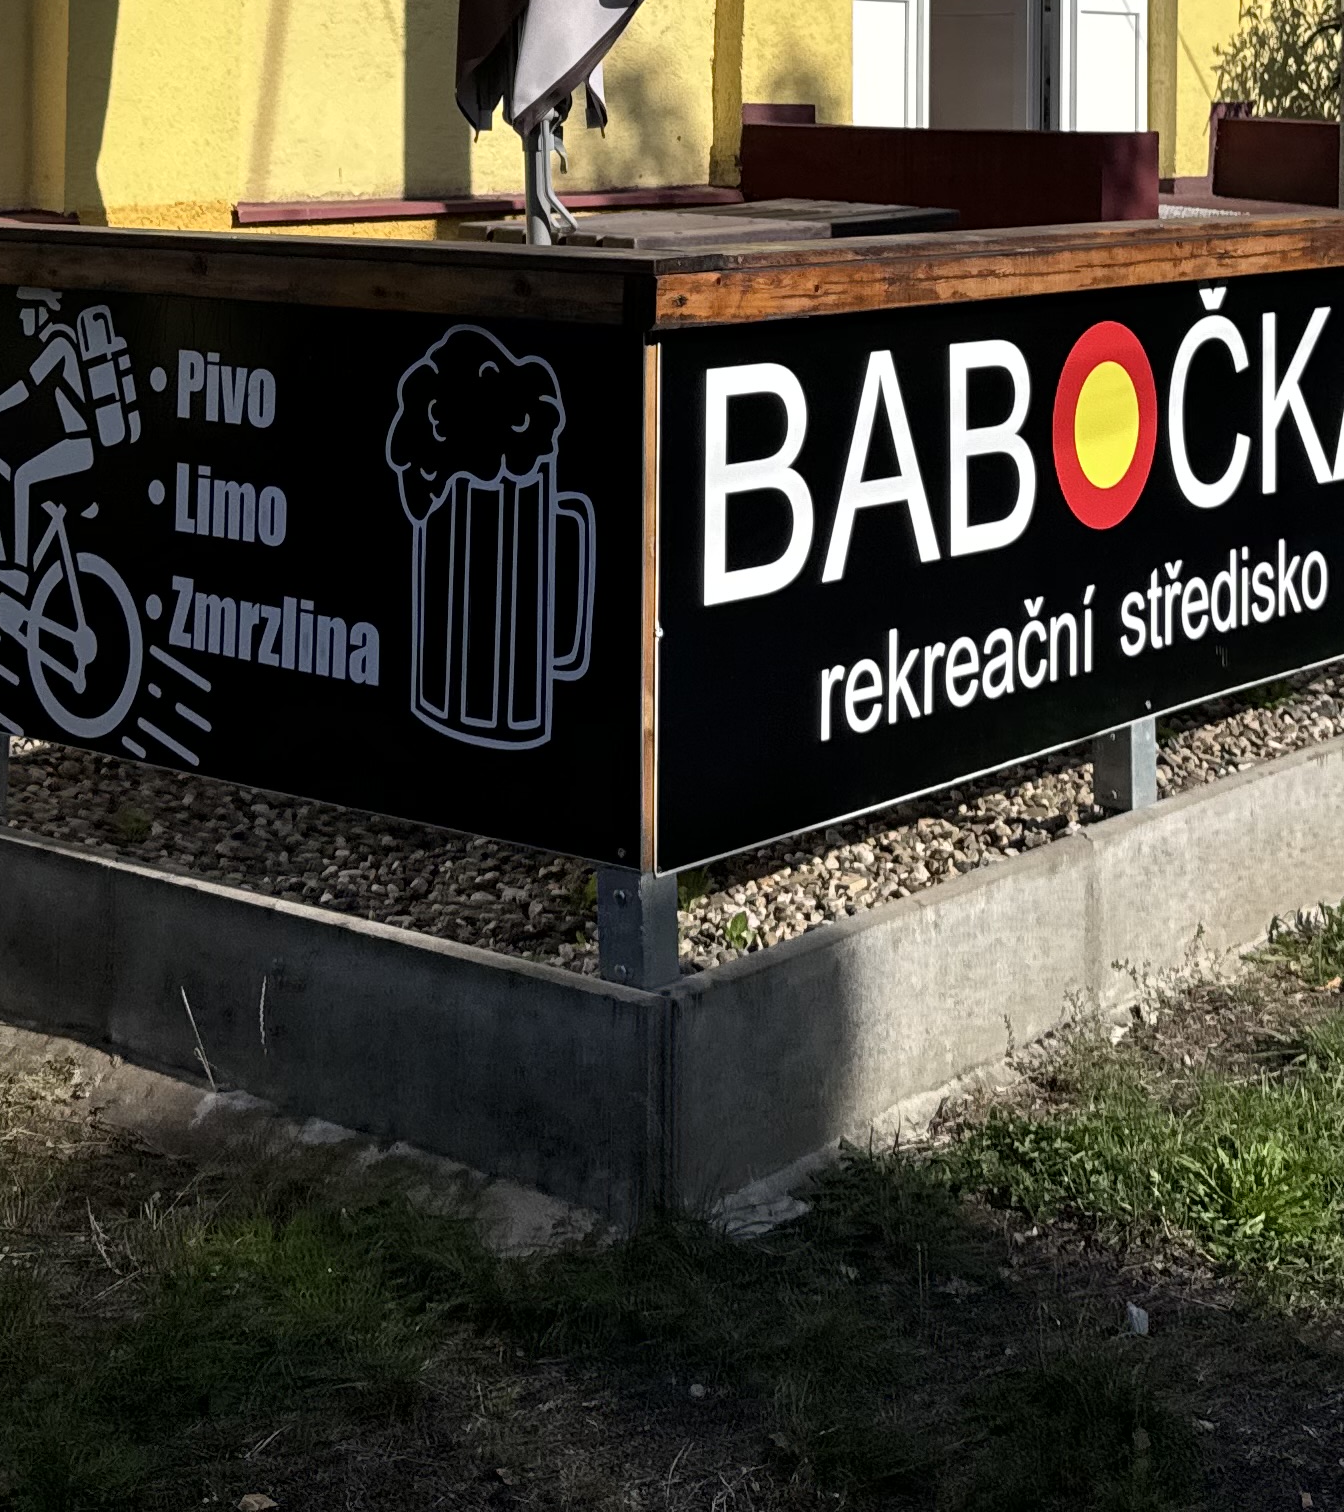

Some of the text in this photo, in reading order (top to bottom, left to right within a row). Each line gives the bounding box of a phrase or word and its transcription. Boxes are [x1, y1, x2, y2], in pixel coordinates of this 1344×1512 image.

[177, 349, 277, 429] Pivo
[175, 462, 288, 548] Limo
[168, 575, 380, 687] Zmrzlina
[820, 538, 1329, 742] rekreační středisko
